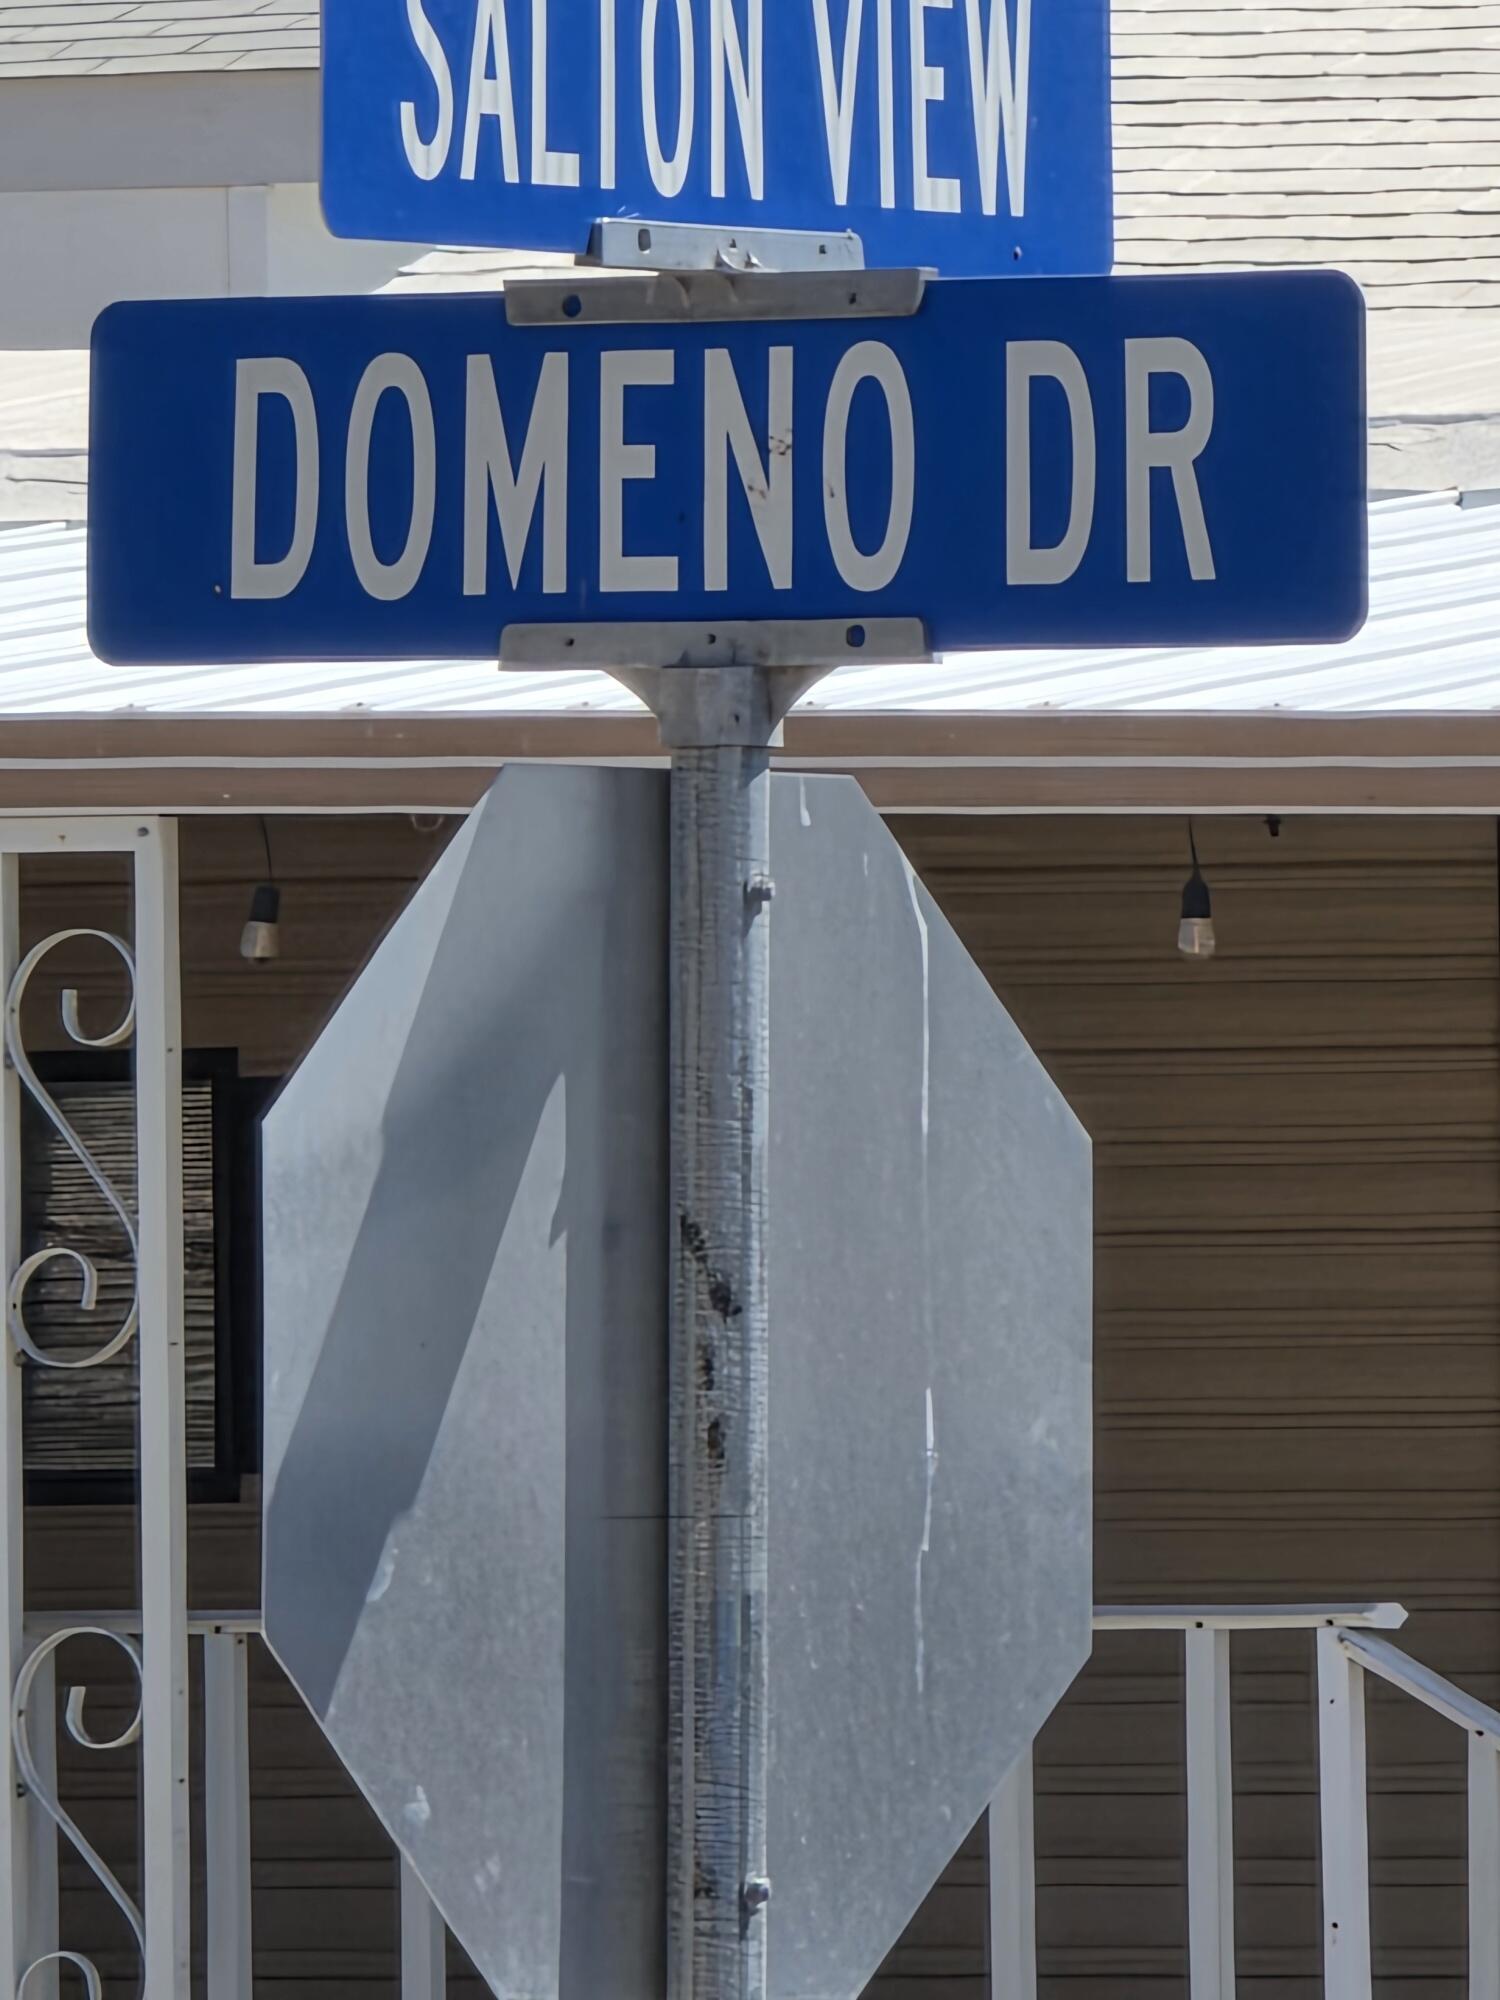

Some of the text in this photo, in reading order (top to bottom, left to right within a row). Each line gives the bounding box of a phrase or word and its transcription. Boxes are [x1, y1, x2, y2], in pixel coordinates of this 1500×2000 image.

[401, 0, 1031, 218] SALTON VIEW
[231, 338, 1216, 601] DOMENO DR
